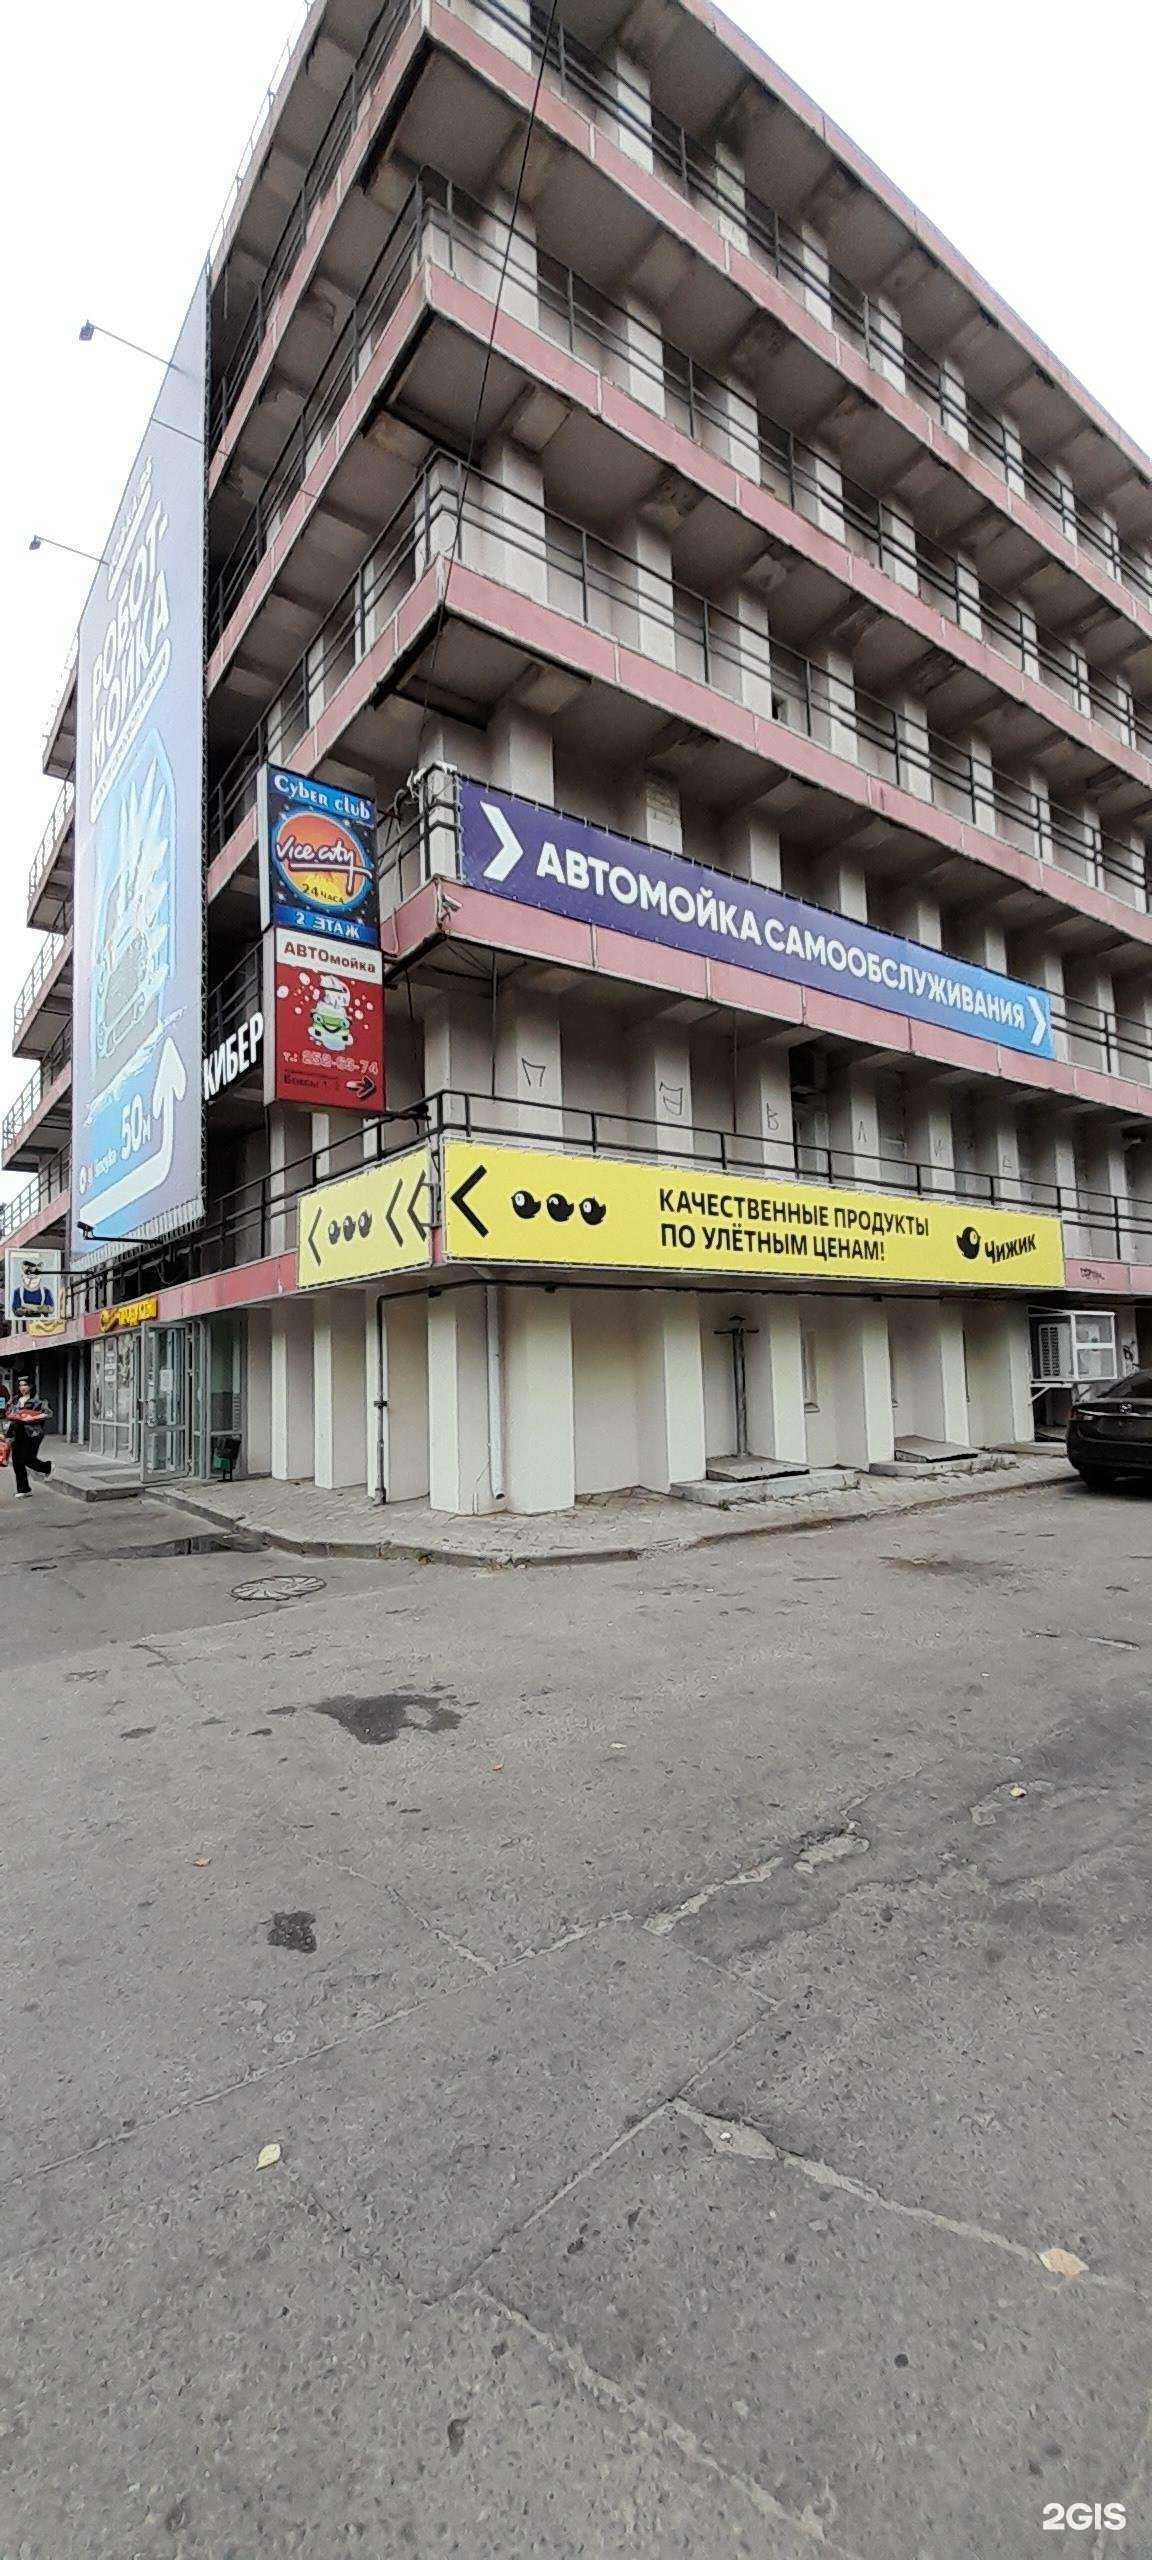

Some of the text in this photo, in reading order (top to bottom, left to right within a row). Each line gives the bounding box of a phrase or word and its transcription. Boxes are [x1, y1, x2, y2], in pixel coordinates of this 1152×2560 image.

[334, 793, 371, 820] club
[302, 883, 319, 898] 24
[295, 913, 361, 938] 2 ЭТАЖ
[536, 841, 1026, 1031] АВТОМОЙКА САМООБСЛУЖИВАНИЯ
[203, 1012, 264, 1101] КИБЕР
[660, 1189, 929, 1237] КАЧЕСТВЕННЫЕ ПРОДУКТЫ
[661, 1223, 886, 1262] ПО УЛЁТНЫМ ЦЕНАМ!
